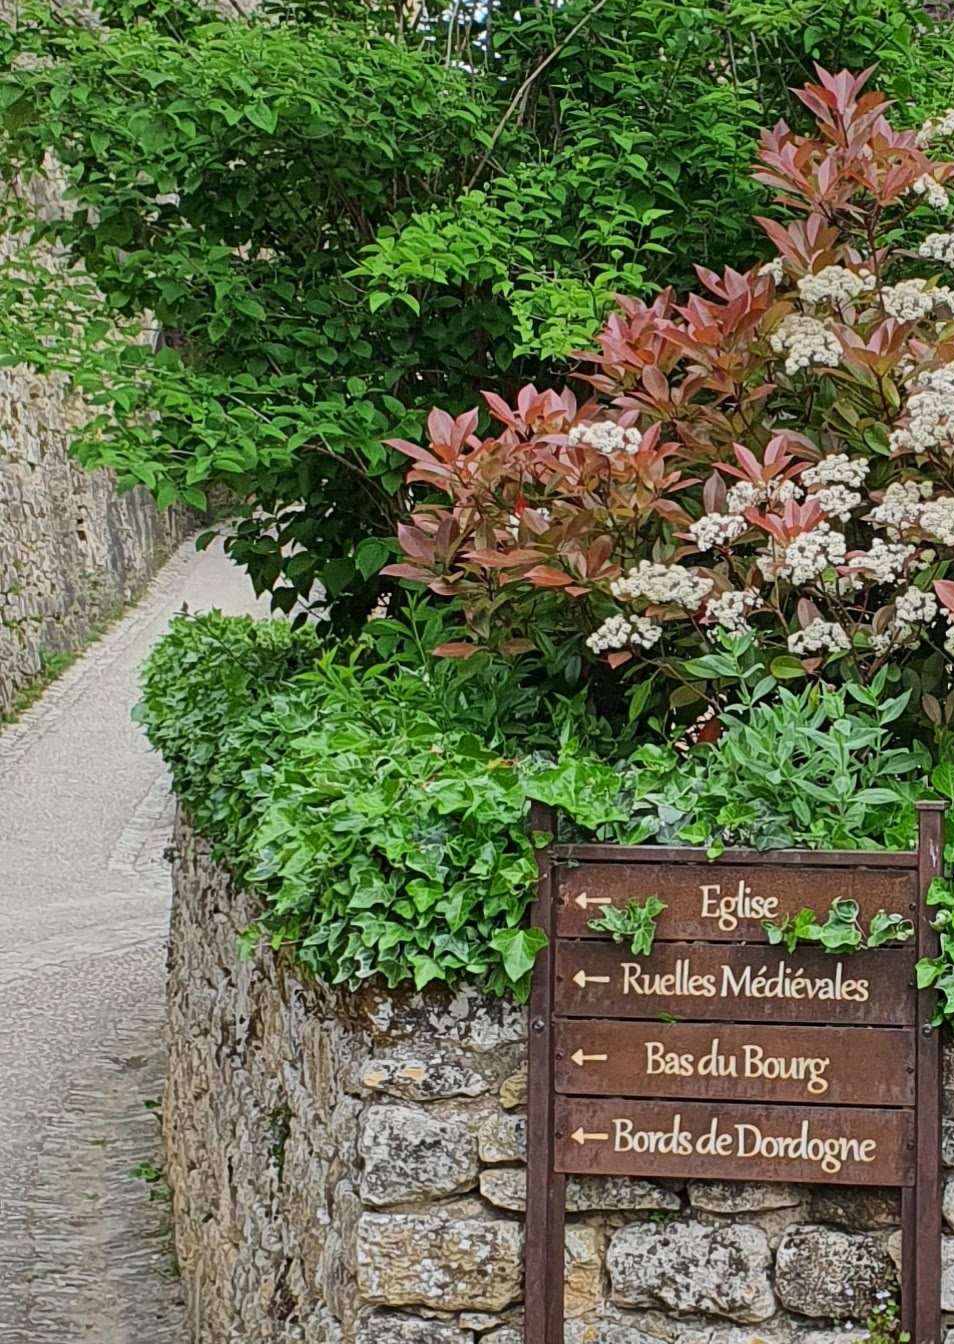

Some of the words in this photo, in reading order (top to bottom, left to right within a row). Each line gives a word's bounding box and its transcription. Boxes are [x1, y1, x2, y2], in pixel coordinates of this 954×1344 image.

[700, 880, 779, 932] Eglise
[620, 959, 717, 998] Ruelles
[720, 962, 869, 1002] Médiévales
[644, 1041, 694, 1077] Bas
[697, 1038, 739, 1078] du
[741, 1044, 830, 1094] Bourg
[611, 1113, 694, 1156] Bords
[695, 1117, 733, 1156] de
[734, 1119, 877, 1174] Dordogne
